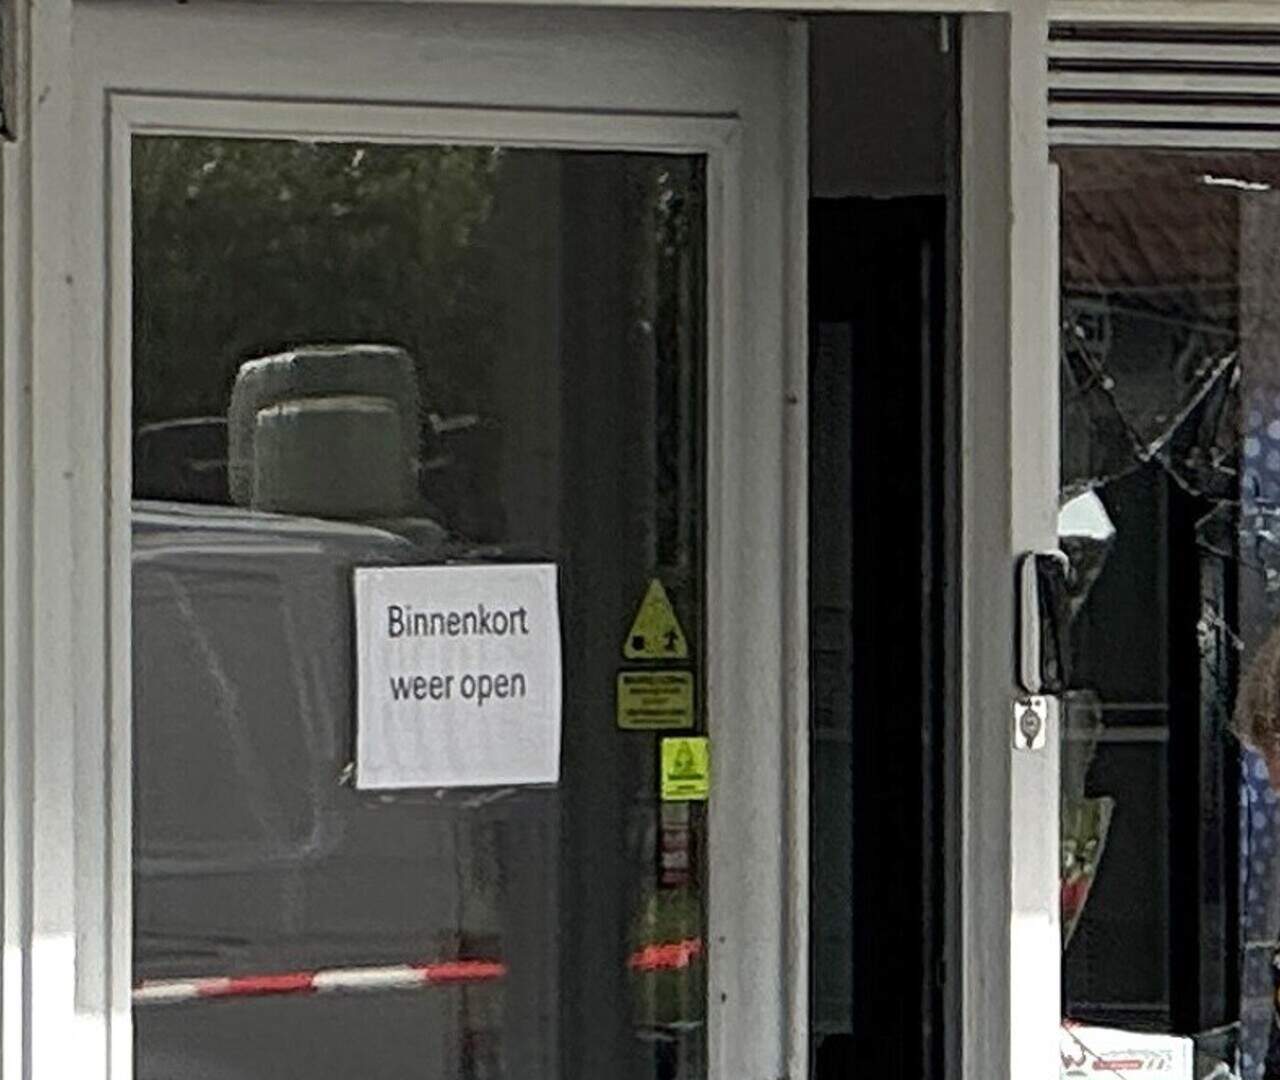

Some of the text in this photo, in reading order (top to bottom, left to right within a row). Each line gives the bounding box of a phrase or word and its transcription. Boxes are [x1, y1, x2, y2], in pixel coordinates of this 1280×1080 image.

[387, 603, 529, 638] Binnenkort
[389, 671, 527, 707] weer open
